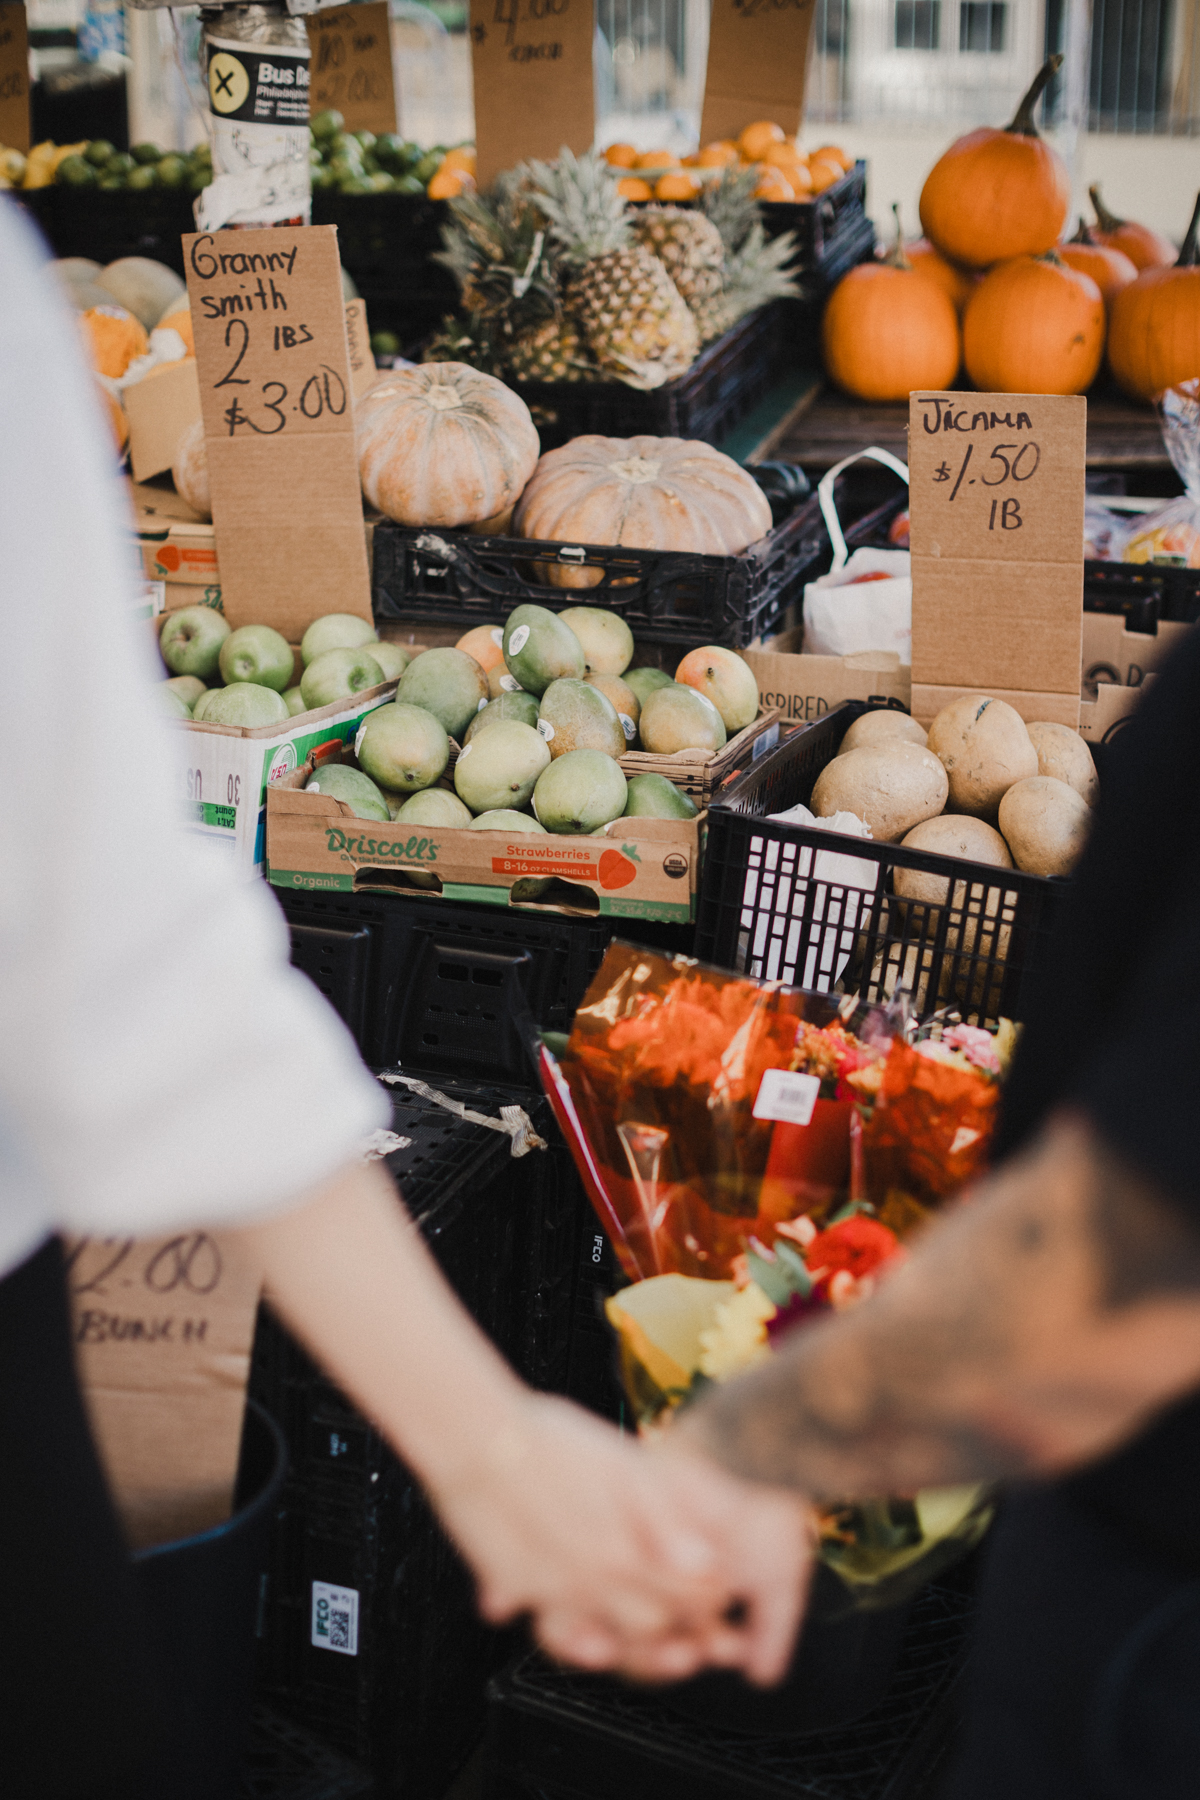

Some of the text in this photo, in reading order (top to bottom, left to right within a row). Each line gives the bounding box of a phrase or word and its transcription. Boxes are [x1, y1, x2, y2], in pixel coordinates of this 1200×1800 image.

[258, 62, 295, 85] Bus
[191, 235, 298, 279] Granny
[200, 277, 287, 319] smith
[213, 318, 251, 388] 2
[224, 363, 346, 436] $3.00
[932, 441, 1041, 501] $1.50
[227, 773, 241, 806] 30
[215, 805, 237, 819] Count
[325, 828, 441, 861] Driscoll's
[506, 845, 591, 861] Strawberries
[293, 874, 340, 888] Organic
[503, 861, 528, 872] 8-16
[592, 1234, 603, 1263] IFCO
[317, 1598, 329, 1637] IFCO
